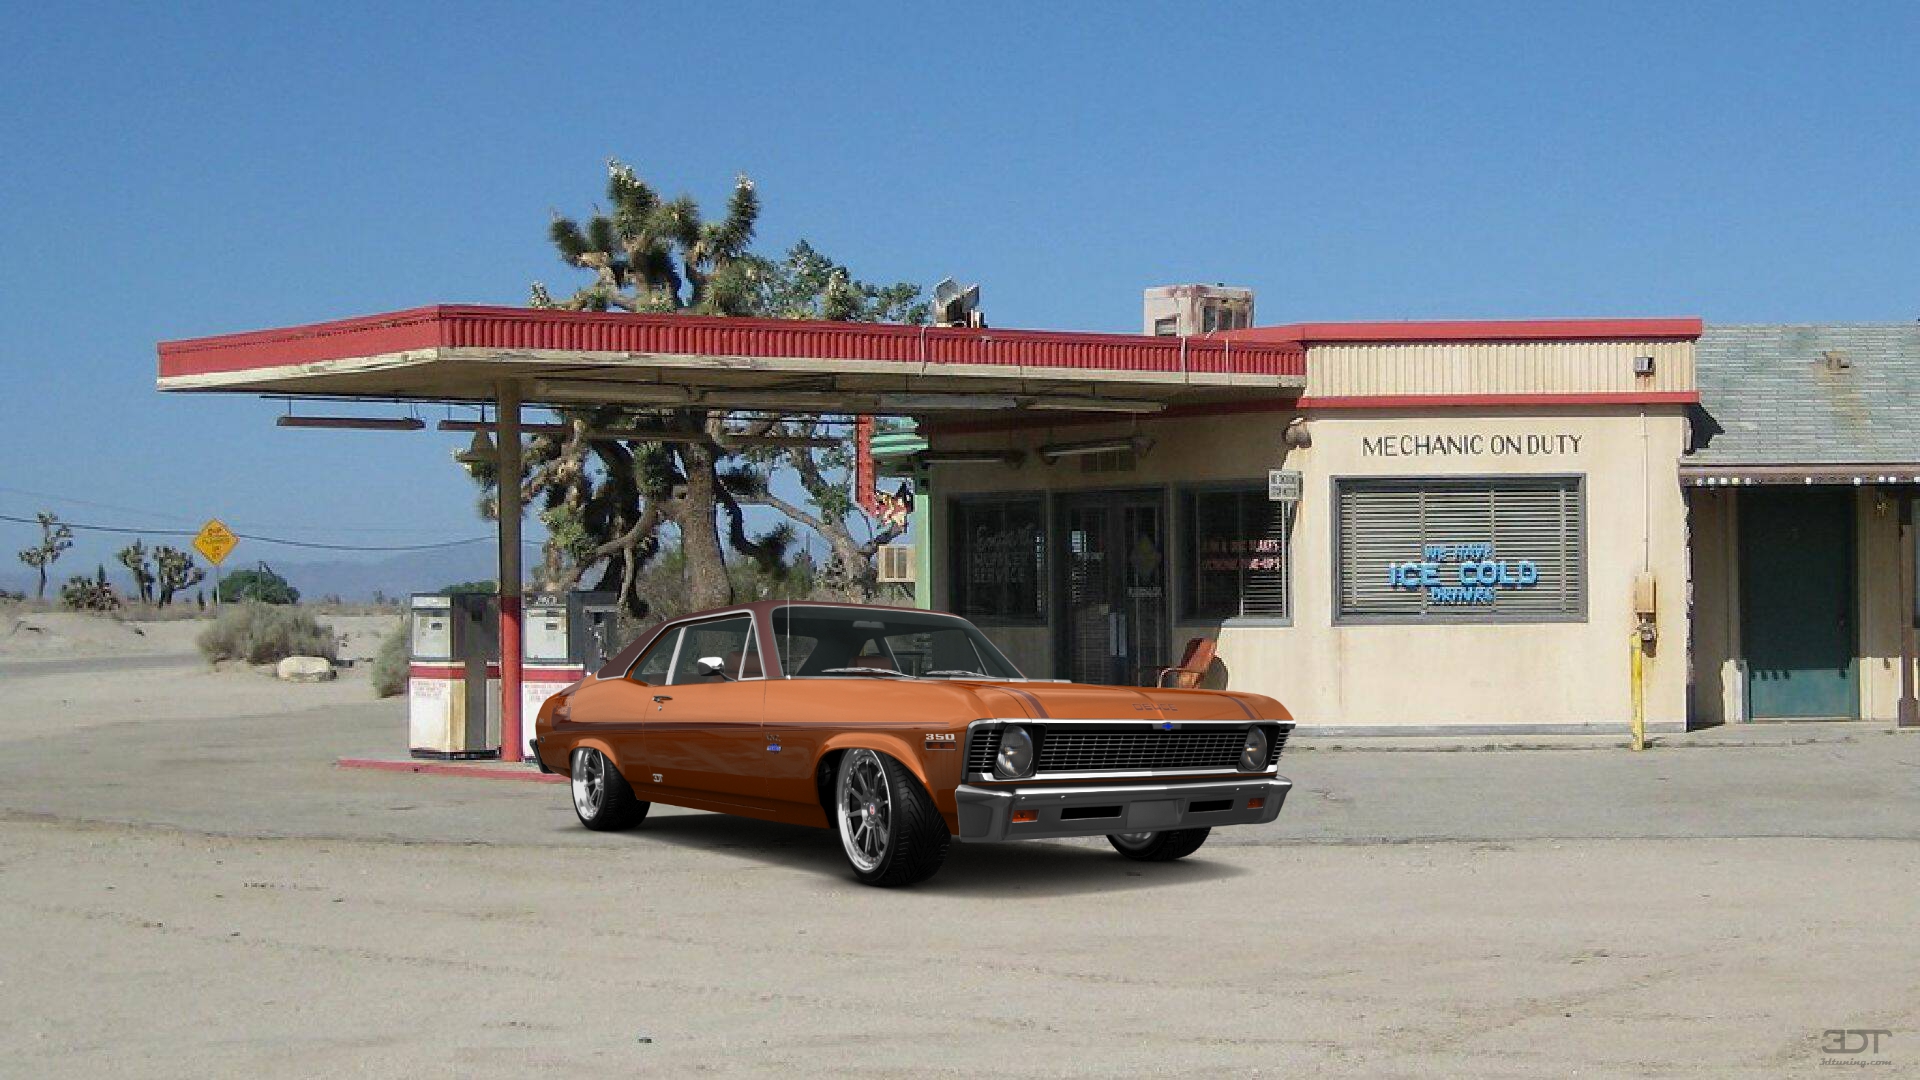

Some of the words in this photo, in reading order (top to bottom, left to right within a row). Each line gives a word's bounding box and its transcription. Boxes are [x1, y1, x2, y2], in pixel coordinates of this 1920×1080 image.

[1362, 434, 1483, 456] MECHANIC
[1490, 434, 1522, 455] ON
[1527, 434, 1583, 455] DUTY
[1389, 562, 1441, 587] ICE
[1459, 560, 1539, 586] COLD
[925, 733, 955, 741] 350
